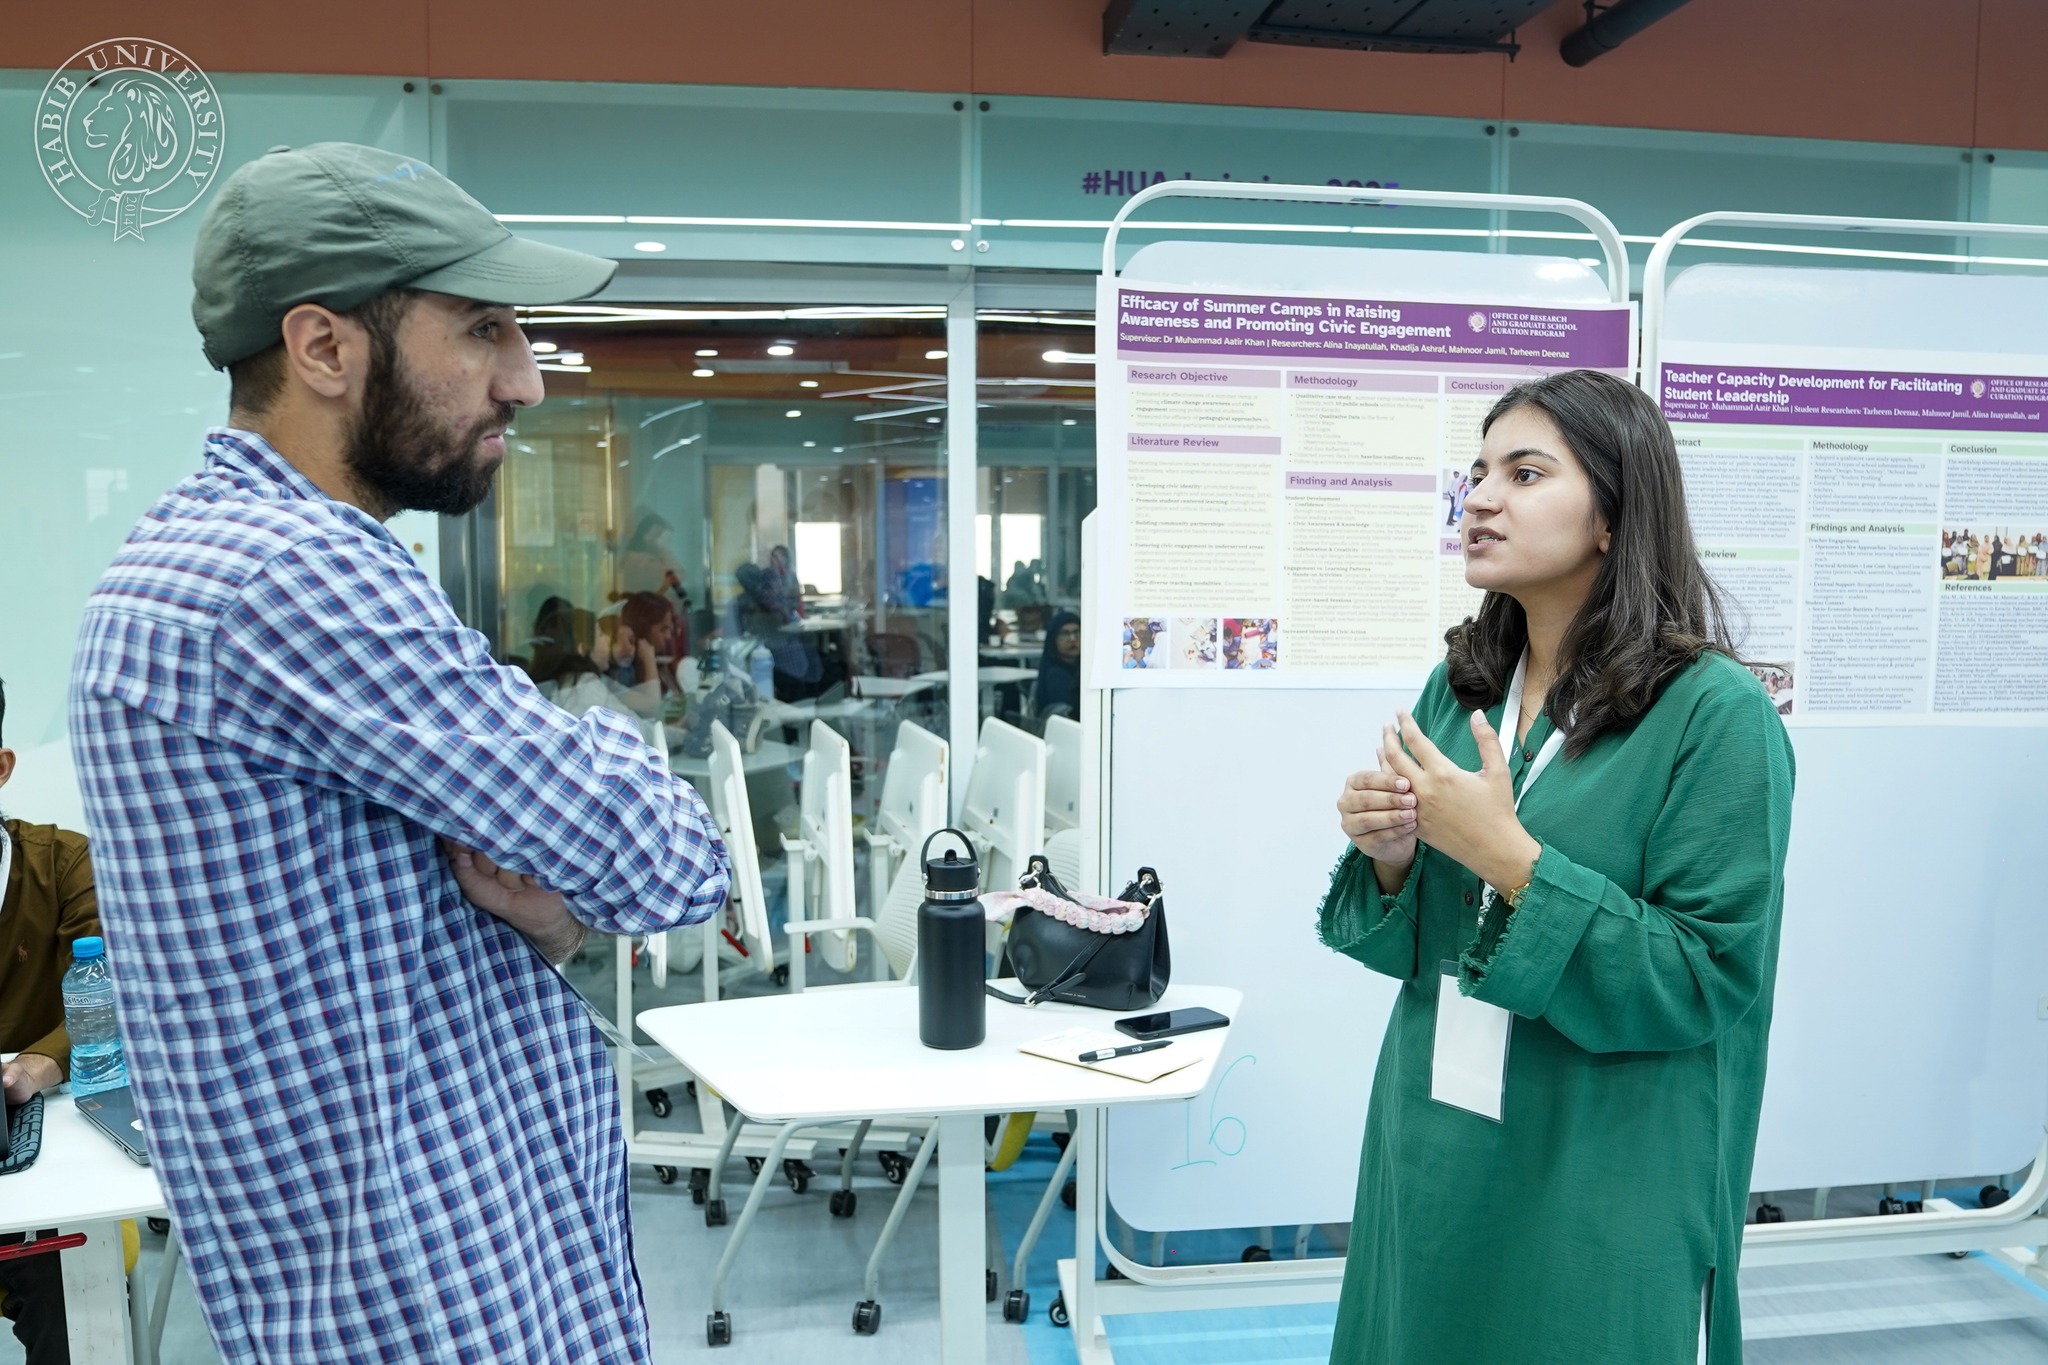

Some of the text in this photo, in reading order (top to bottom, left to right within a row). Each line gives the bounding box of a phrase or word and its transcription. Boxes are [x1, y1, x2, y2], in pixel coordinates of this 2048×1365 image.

[1121, 295, 1403, 322] Efficacy of Summer Camps in Raising
[1492, 312, 1518, 320] OFFICE
[1530, 314, 1567, 322] RESEARCH
[1121, 313, 1200, 328] Awareness
[1204, 316, 1232, 329] and
[1236, 317, 1314, 335] Promoting
[1317, 320, 1356, 333] Civic
[1360, 322, 1451, 340] Engagement
[1508, 320, 1545, 329] GRADUATE
[1547, 322, 1577, 331] SCHOOL
[1492, 327, 1565, 338] CURATION PROGRAM
[1120, 332, 1161, 344] Supervisor:
[1163, 334, 1173, 342] Dr
[1174, 334, 1222, 344] Muhammad
[1223, 336, 1242, 345] Aatir
[1244, 337, 1265, 346] Khan
[1271, 338, 1321, 348] Researchers:
[1323, 340, 1342, 349] Alina
[1344, 341, 1388, 353] Inayatullah,
[1390, 342, 1419, 354] Khadija
[1420, 344, 1446, 355] Ashraf,
[1448, 345, 1482, 354] Mahnoor
[1484, 346, 1507, 357] Jamil,
[1509, 347, 1540, 356] Tarheem
[1541, 348, 1569, 358] Deenaz
[1131, 370, 1228, 384] Research Objective
[1294, 375, 1358, 388] Methodology
[1665, 370, 1713, 383] Teacher
[1716, 372, 1775, 388] Capacity
[1778, 374, 1864, 392] Development
[1868, 378, 1887, 390] for
[1890, 378, 1962, 395] Facilitating
[1451, 380, 1504, 391] Conclusion
[1665, 387, 1789, 406] Student Leadership
[1664, 411, 1710, 420] Khadija Ashraf.
[1665, 401, 1698, 411] Supervisor:
[1699, 402, 1710, 410] Dr.
[1711, 403, 1753, 411] Muhammad
[1794, 405, 1819, 413] Student
[1820, 406, 1861, 414] Researchers:
[1862, 407, 1892, 415] Tarheem
[1893, 408, 1920, 418] Deenaz,
[1921, 409, 1950, 417] Mahnoor
[1951, 410, 1970, 419] Jamil,
[1990, 411, 2026, 421] Inayatullah,
[2027, 412, 2040, 420] and
[1131, 436, 1219, 447] Literature Review
[1813, 441, 1869, 452] Methodology
[1950, 444, 1997, 454] Conclusion
[1290, 476, 1392, 489] Finding and Analysis
[1810, 523, 1905, 535] Findings and Analysis
[1705, 549, 1737, 558] Review
[1945, 582, 1992, 592] References
[1171, 1054, 1257, 1170] 16
